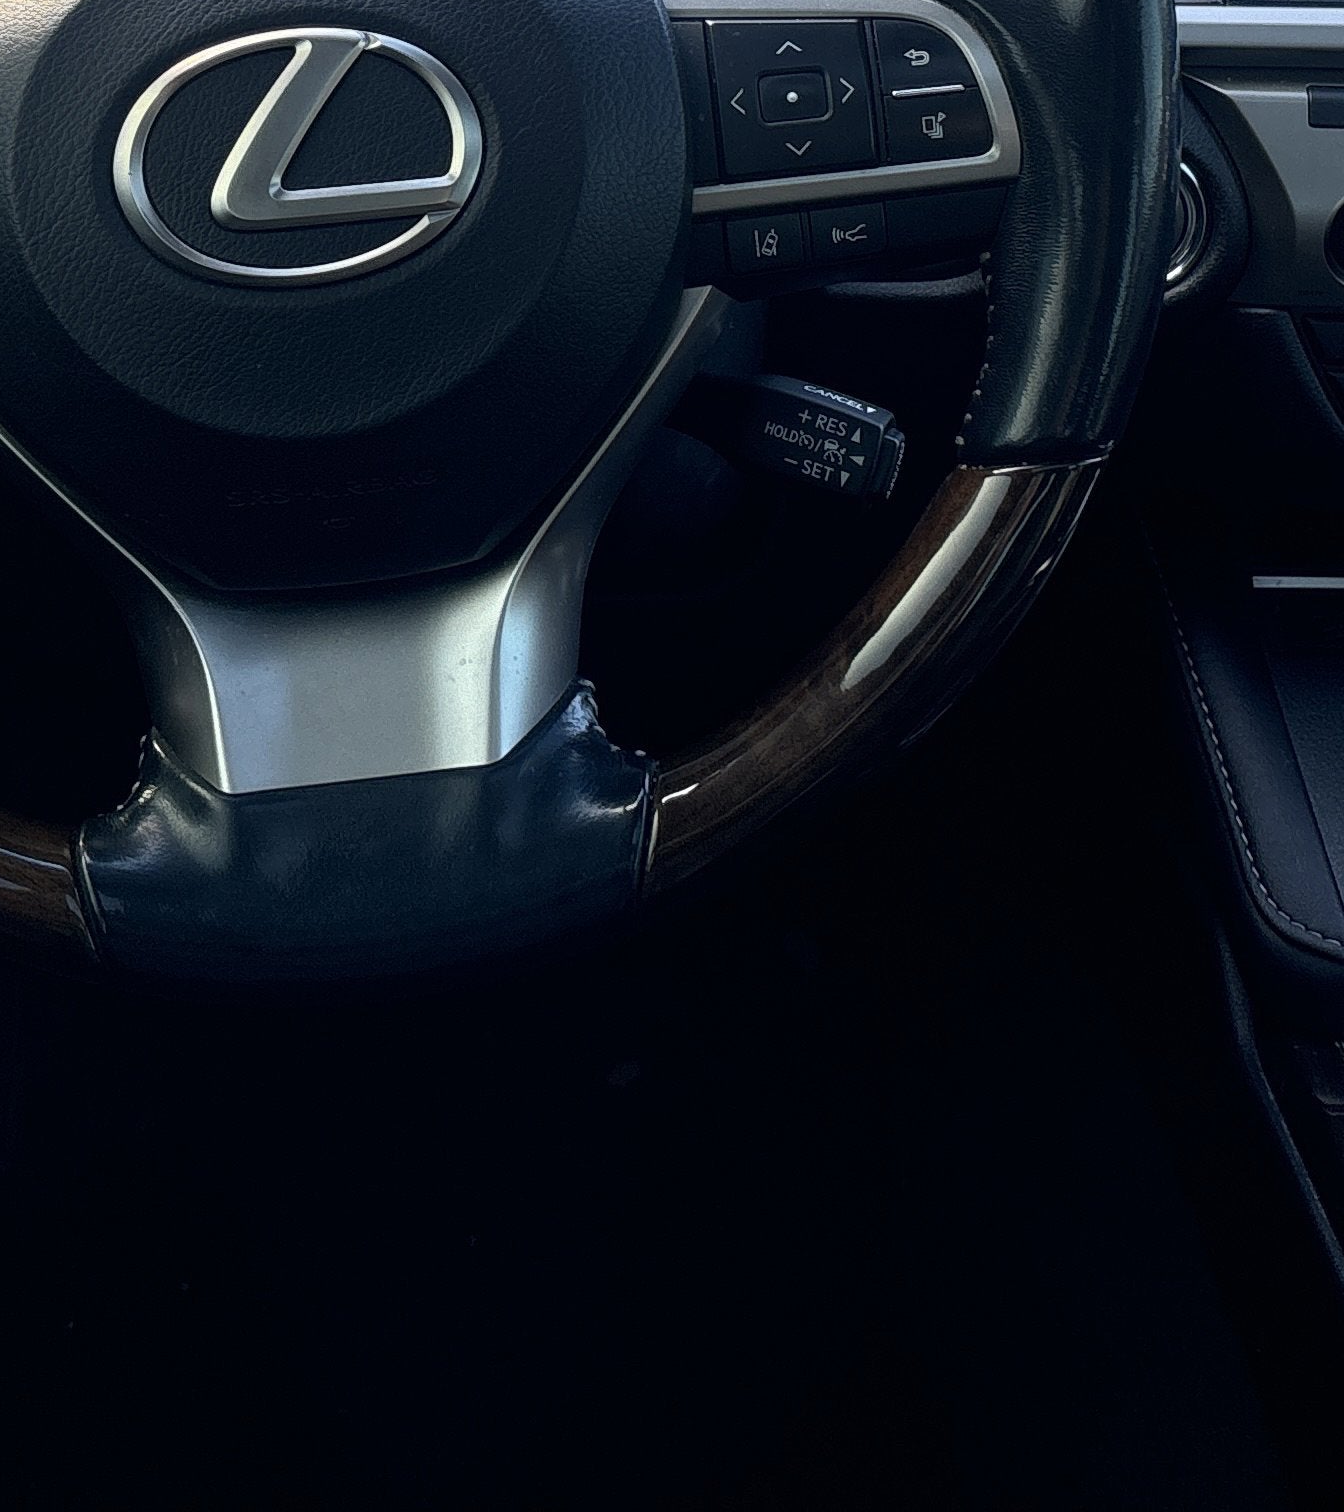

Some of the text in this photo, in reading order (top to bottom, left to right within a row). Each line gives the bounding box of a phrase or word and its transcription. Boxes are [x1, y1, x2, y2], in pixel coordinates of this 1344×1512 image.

[803, 385, 864, 412] CANCEL
[763, 420, 799, 443] HOLD
[815, 413, 849, 437] RES
[801, 458, 835, 482] SET
